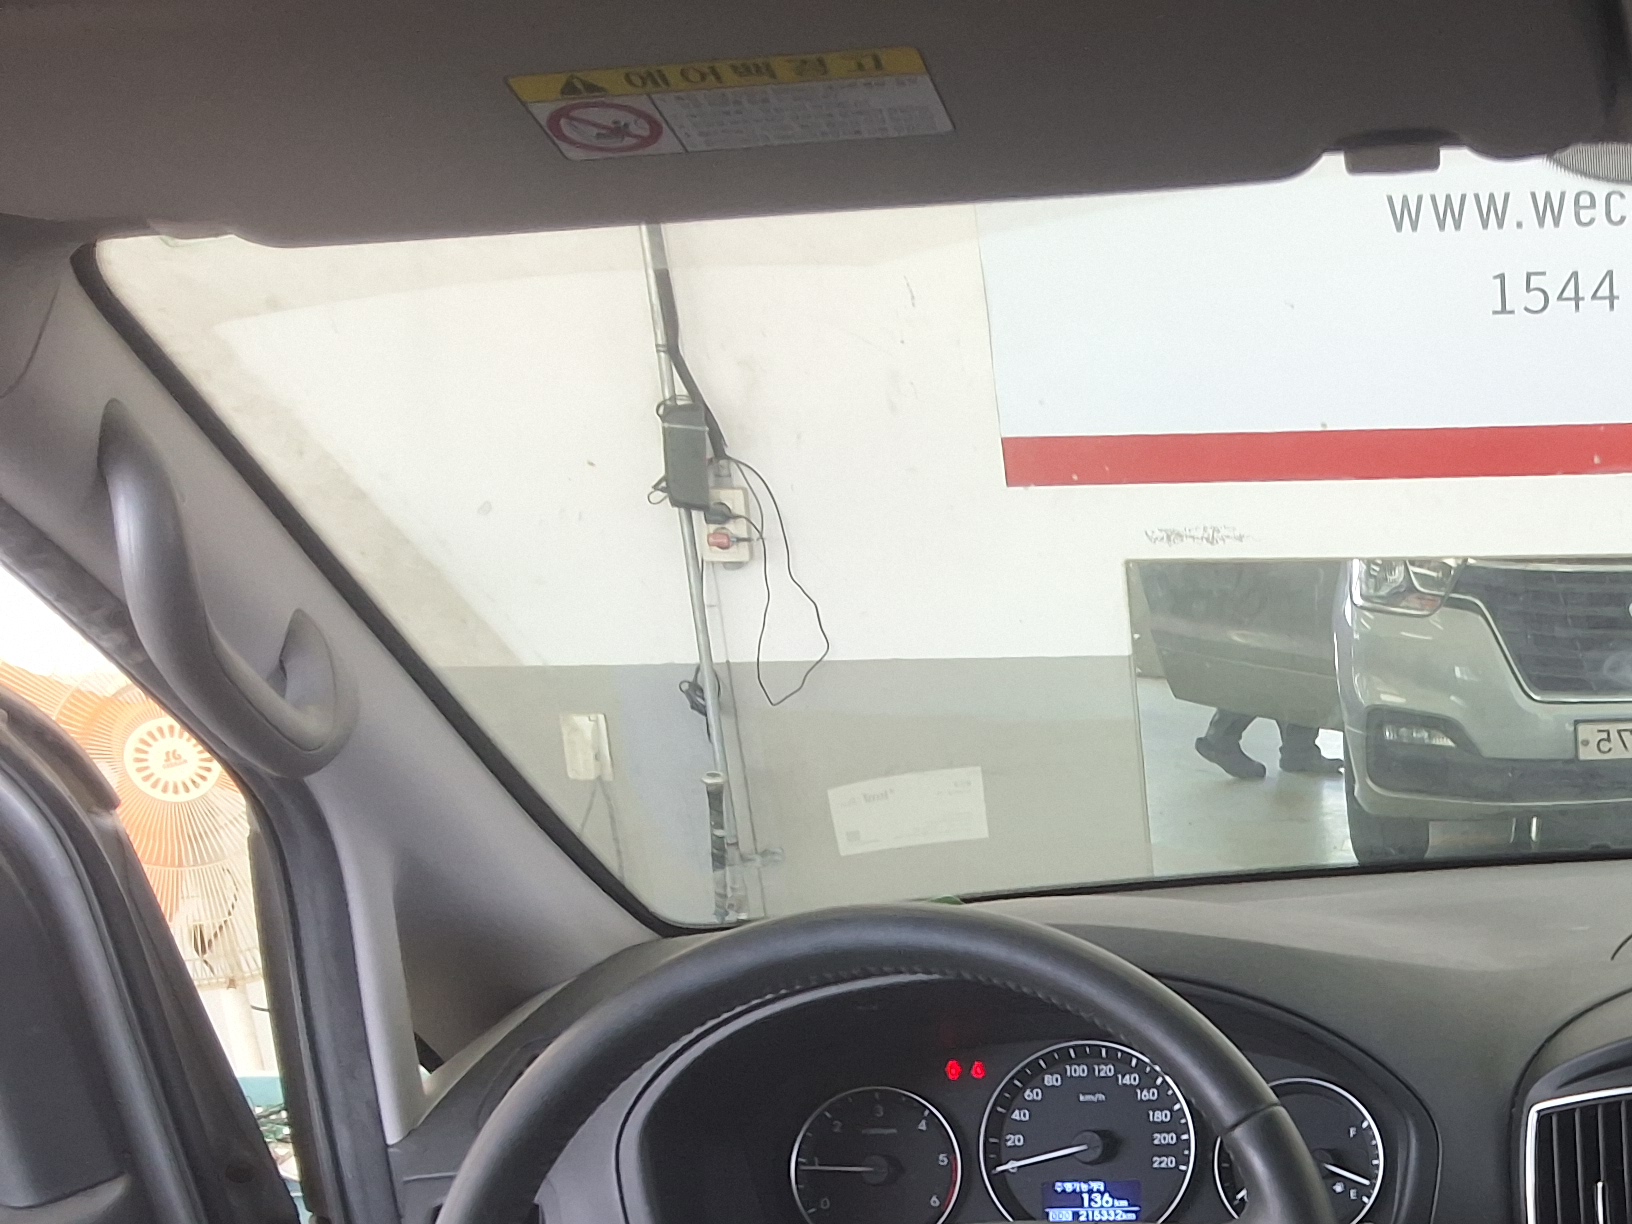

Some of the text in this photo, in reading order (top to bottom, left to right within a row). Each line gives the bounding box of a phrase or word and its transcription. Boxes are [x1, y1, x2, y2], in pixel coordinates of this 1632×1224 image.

[1490, 269, 1620, 316] 1544
[1065, 1065, 1088, 1077] 100
[1093, 1065, 1115, 1077] 120
[1044, 1074, 1062, 1086] 80
[1117, 1073, 1139, 1086] 140
[1024, 1088, 1042, 1101] 60
[1079, 1092, 1106, 1102] km/h
[1136, 1088, 1158, 1101] 160
[874, 1105, 884, 1117] 3
[1011, 1109, 1030, 1121] 40
[1148, 1110, 1171, 1122] 180
[832, 1120, 843, 1133] 2
[917, 1119, 927, 1131] 4
[1349, 1126, 1357, 1138] F
[1005, 1134, 1024, 1146] 20
[1152, 1133, 1177, 1145] 200
[938, 1153, 949, 1166] 5
[1152, 1156, 1176, 1168] 220
[1349, 1188, 1357, 1200] E
[929, 1194, 940, 1207] 6
